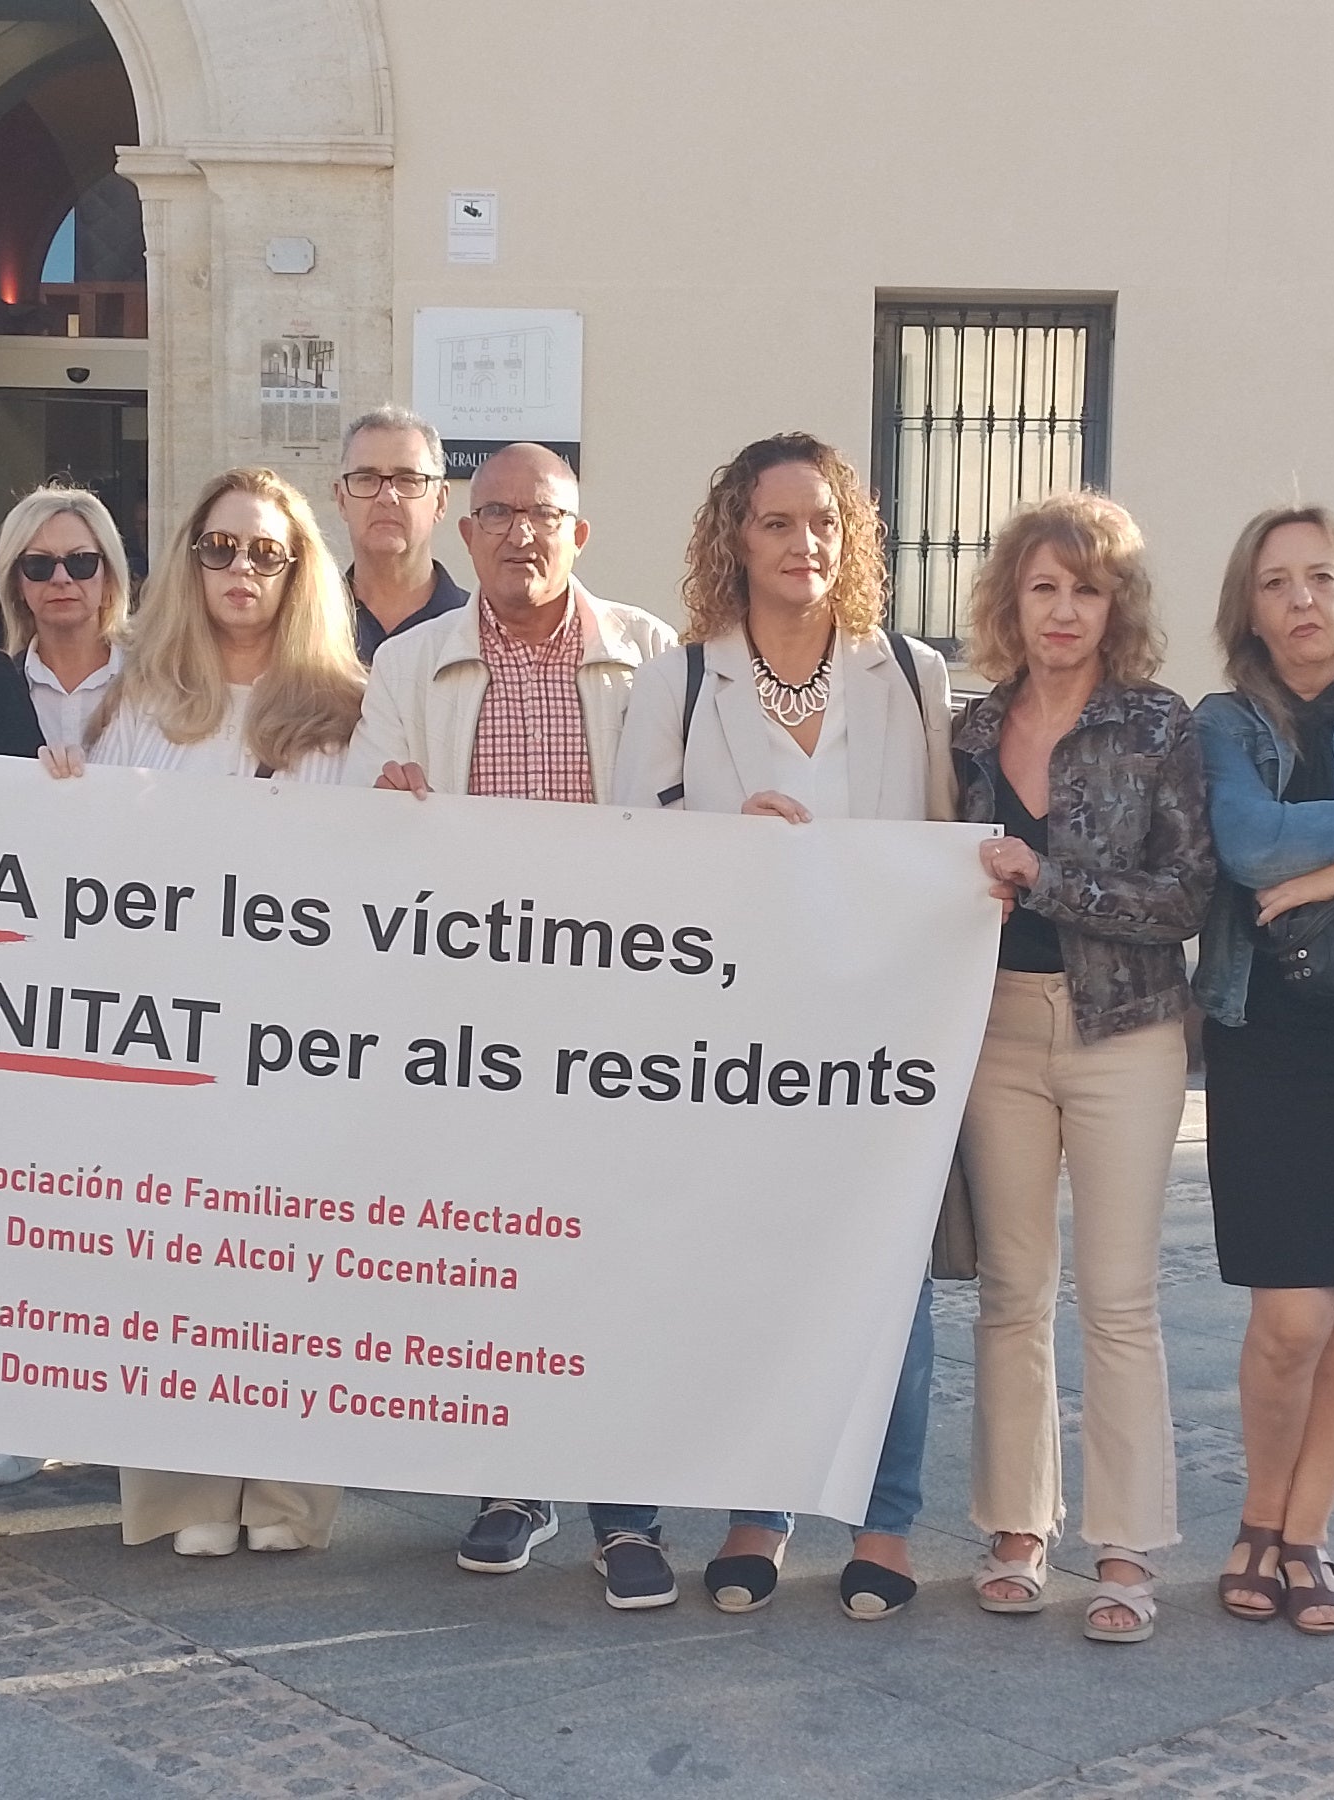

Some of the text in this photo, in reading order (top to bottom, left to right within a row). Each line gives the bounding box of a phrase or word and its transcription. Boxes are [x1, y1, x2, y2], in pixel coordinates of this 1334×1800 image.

[65, 877, 195, 939] per
[222, 874, 330, 946] les
[363, 889, 736, 989] víctimes,
[246, 1023, 379, 1087] per
[404, 1024, 522, 1092] als
[555, 1040, 937, 1107] residents
[136, 1175, 172, 1205] de
[184, 1177, 355, 1224] Familiares
[368, 1196, 406, 1227] de
[418, 1200, 583, 1240] Afectados
[6, 1216, 518, 1291] Domus Vi de Alcoi y Cocentaina
[122, 1312, 159, 1343] de
[171, 1314, 342, 1359] Familiares
[354, 1332, 392, 1363] de
[404, 1335, 585, 1378] Residentes
[1, 1352, 509, 1428] Domus Vi de Alcoi y Cocentaina
